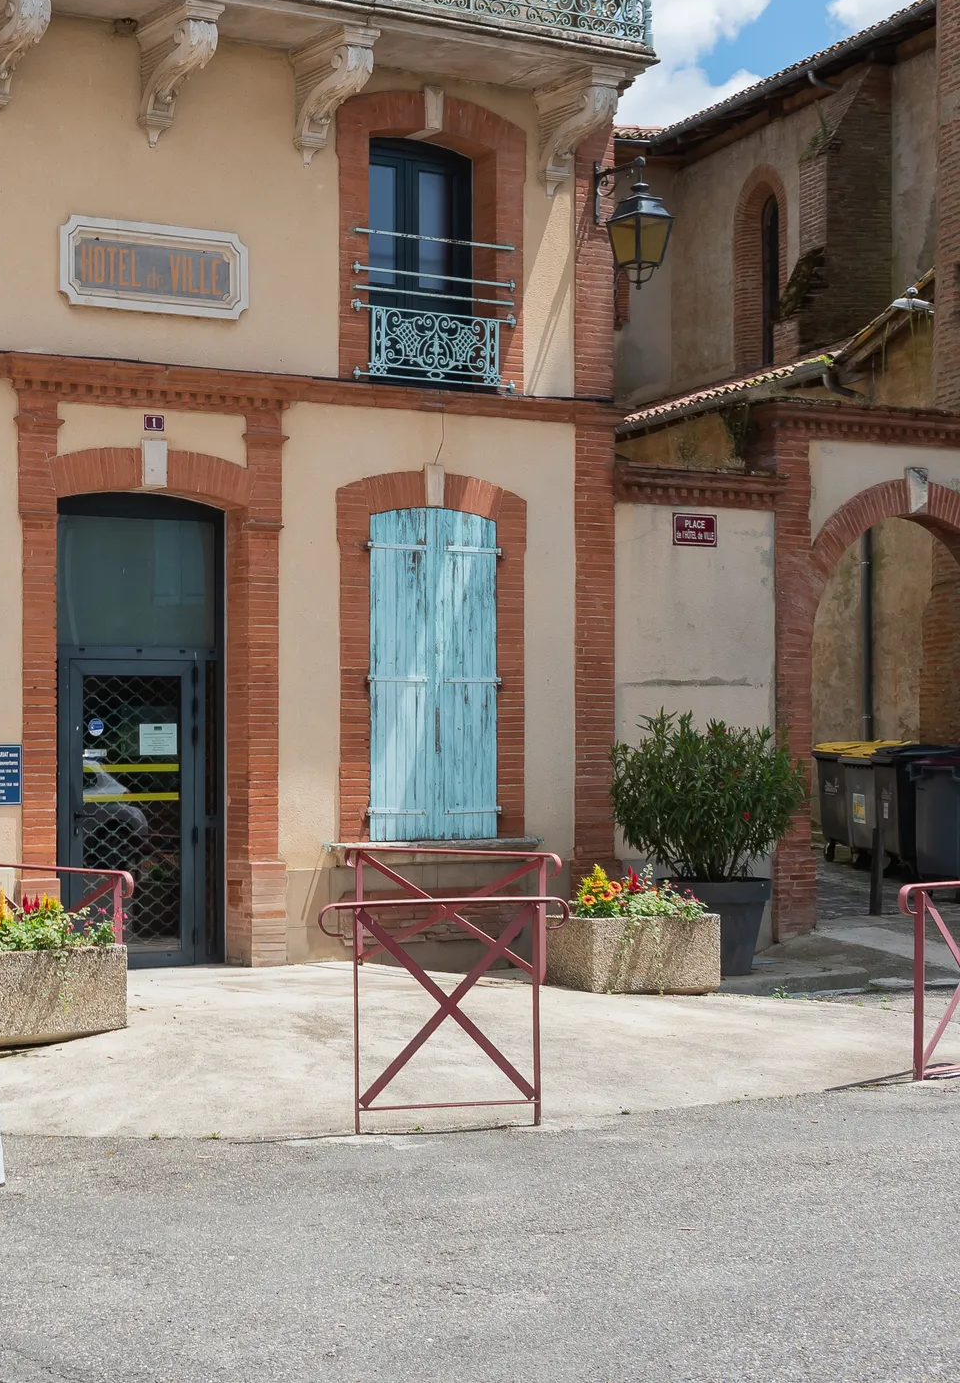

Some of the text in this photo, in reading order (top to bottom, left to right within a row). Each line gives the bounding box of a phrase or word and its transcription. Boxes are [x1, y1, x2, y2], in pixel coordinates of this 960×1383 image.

[81, 244, 222, 296] HOTEL de VILLE
[152, 418, 156, 427] 1
[684, 520, 705, 529] PLACE
[698, 532, 702, 540] de
[704, 531, 714, 541] VILLE
